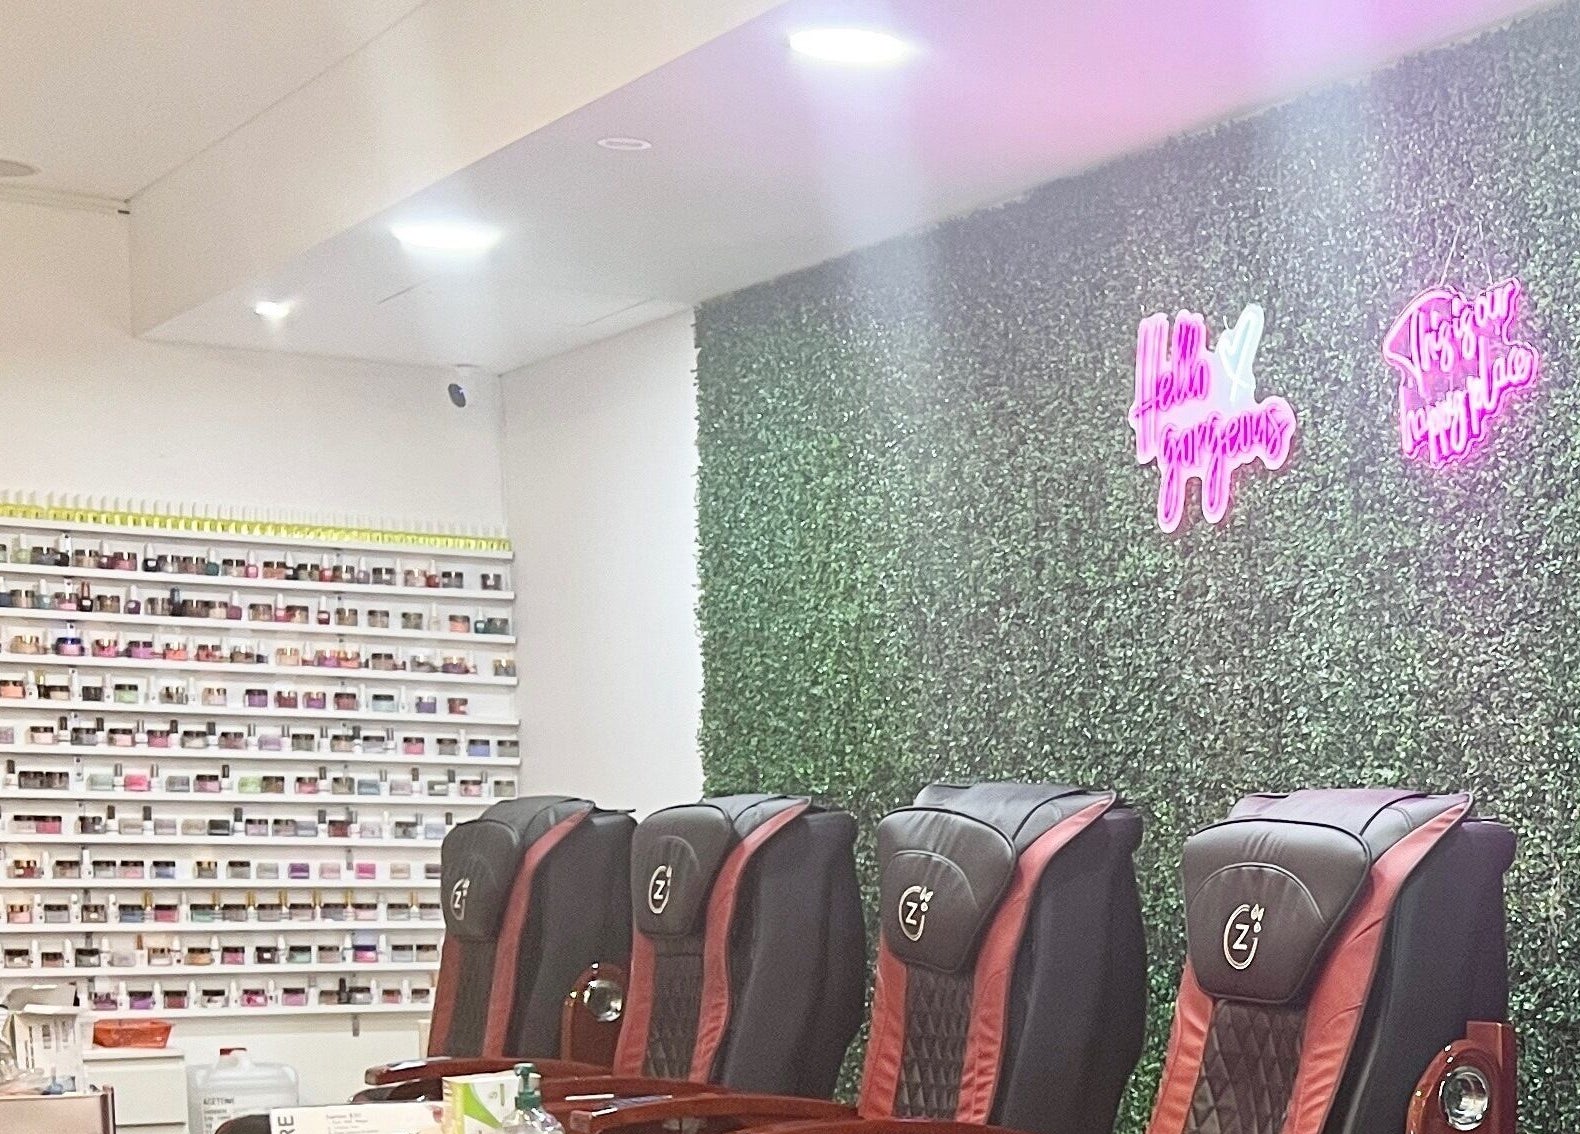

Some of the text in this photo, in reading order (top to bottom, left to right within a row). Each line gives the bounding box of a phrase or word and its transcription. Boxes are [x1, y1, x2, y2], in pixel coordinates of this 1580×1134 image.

[1133, 318, 1209, 457] Hello
[1384, 281, 1517, 400] This is our
[1400, 335, 1533, 464] happy place
[1160, 406, 1290, 523] gorgeous
